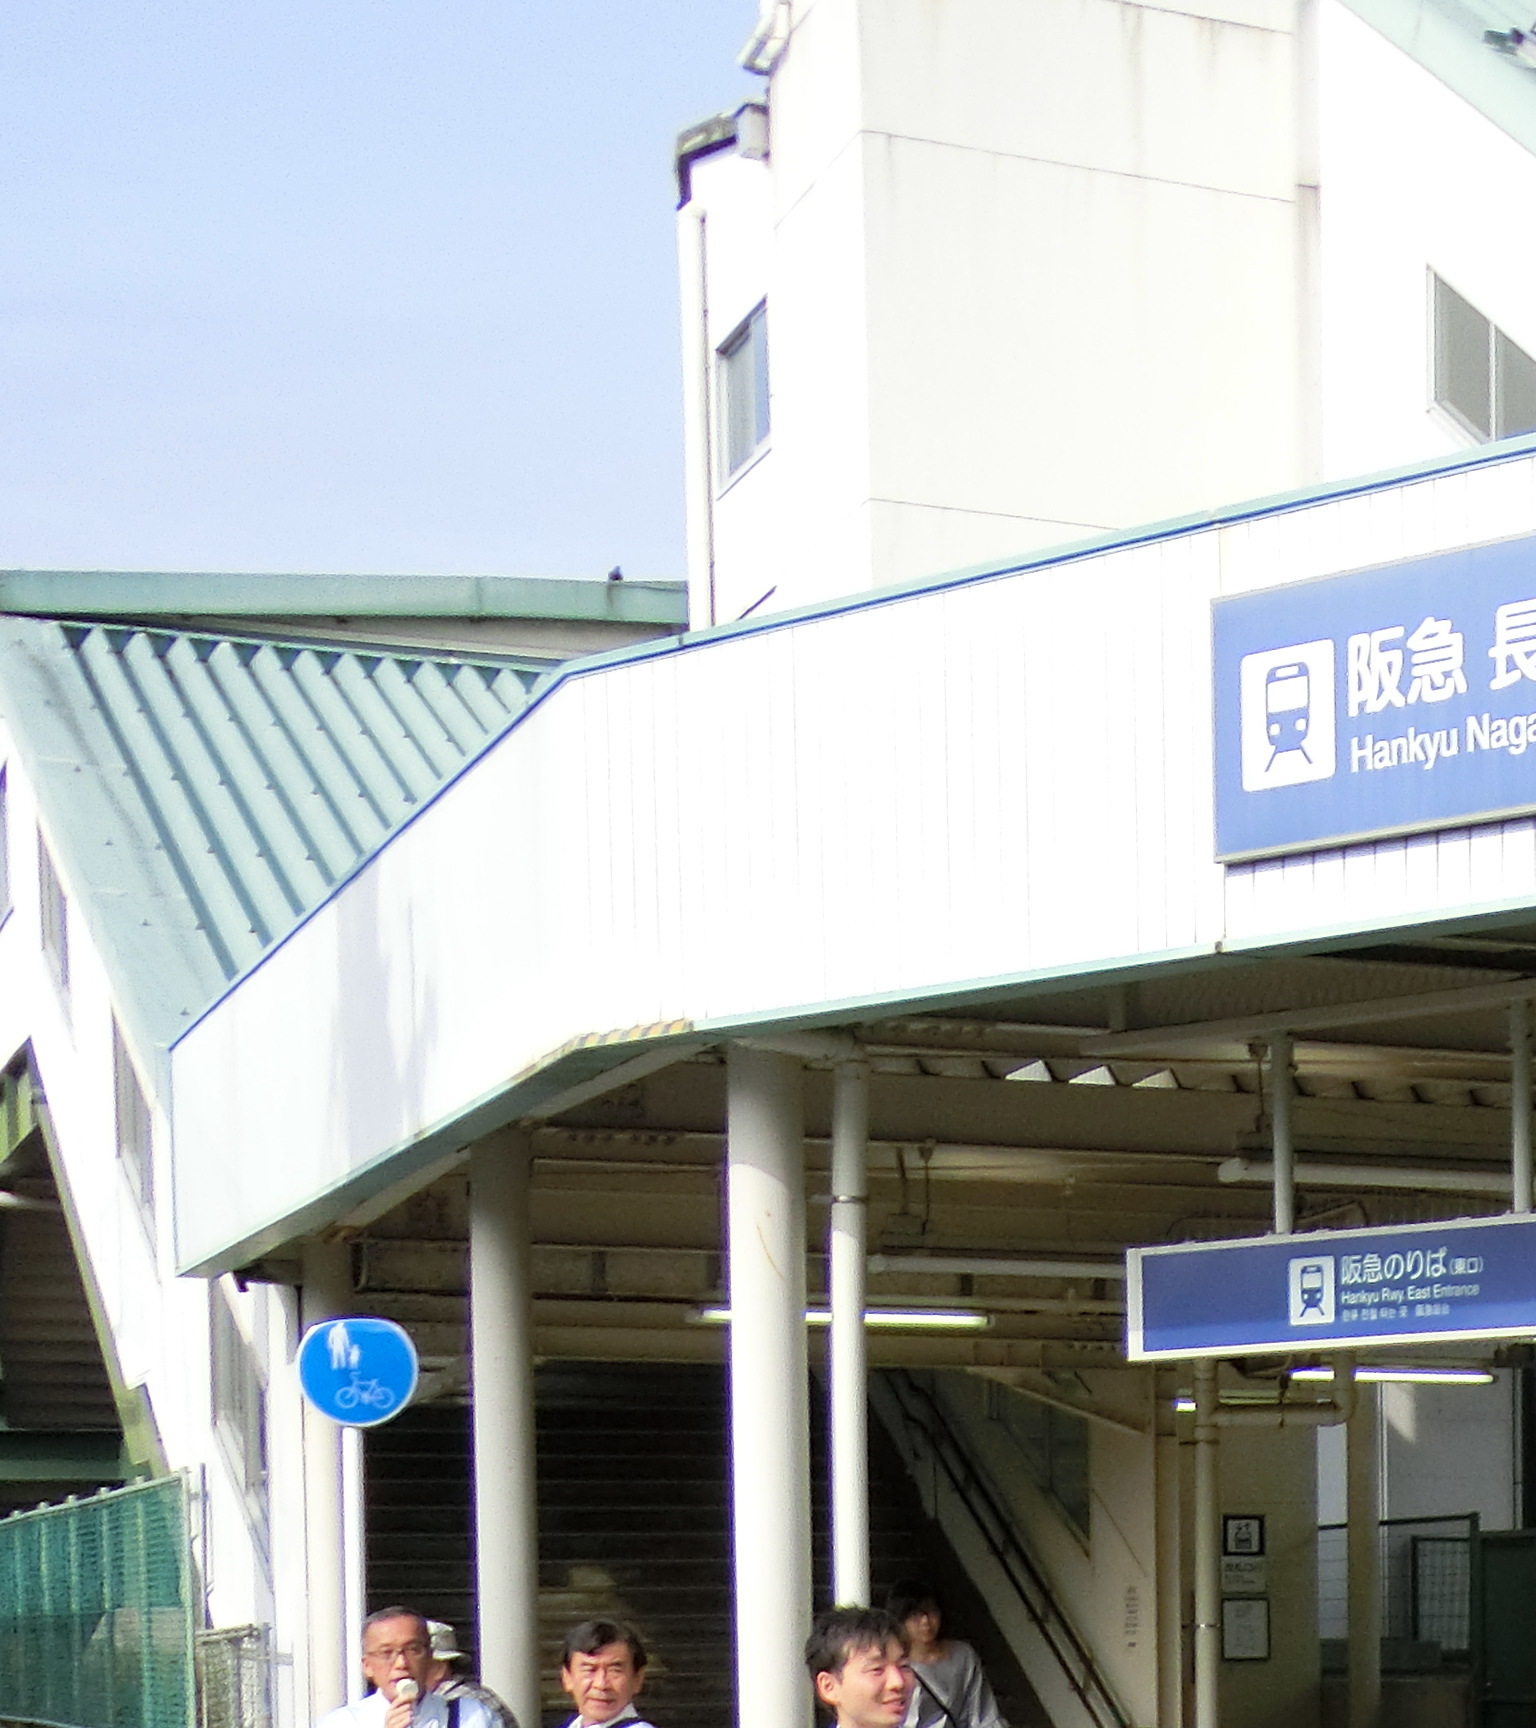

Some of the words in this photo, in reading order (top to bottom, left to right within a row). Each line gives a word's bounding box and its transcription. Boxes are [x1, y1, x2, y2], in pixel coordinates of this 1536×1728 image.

[1346, 617, 1468, 718] 阪急
[1349, 725, 1458, 773] Hankyu
[1341, 1288, 1379, 1306] Hankyu
[1407, 1284, 1431, 1300] East
[1433, 1283, 1480, 1298] Entrance
